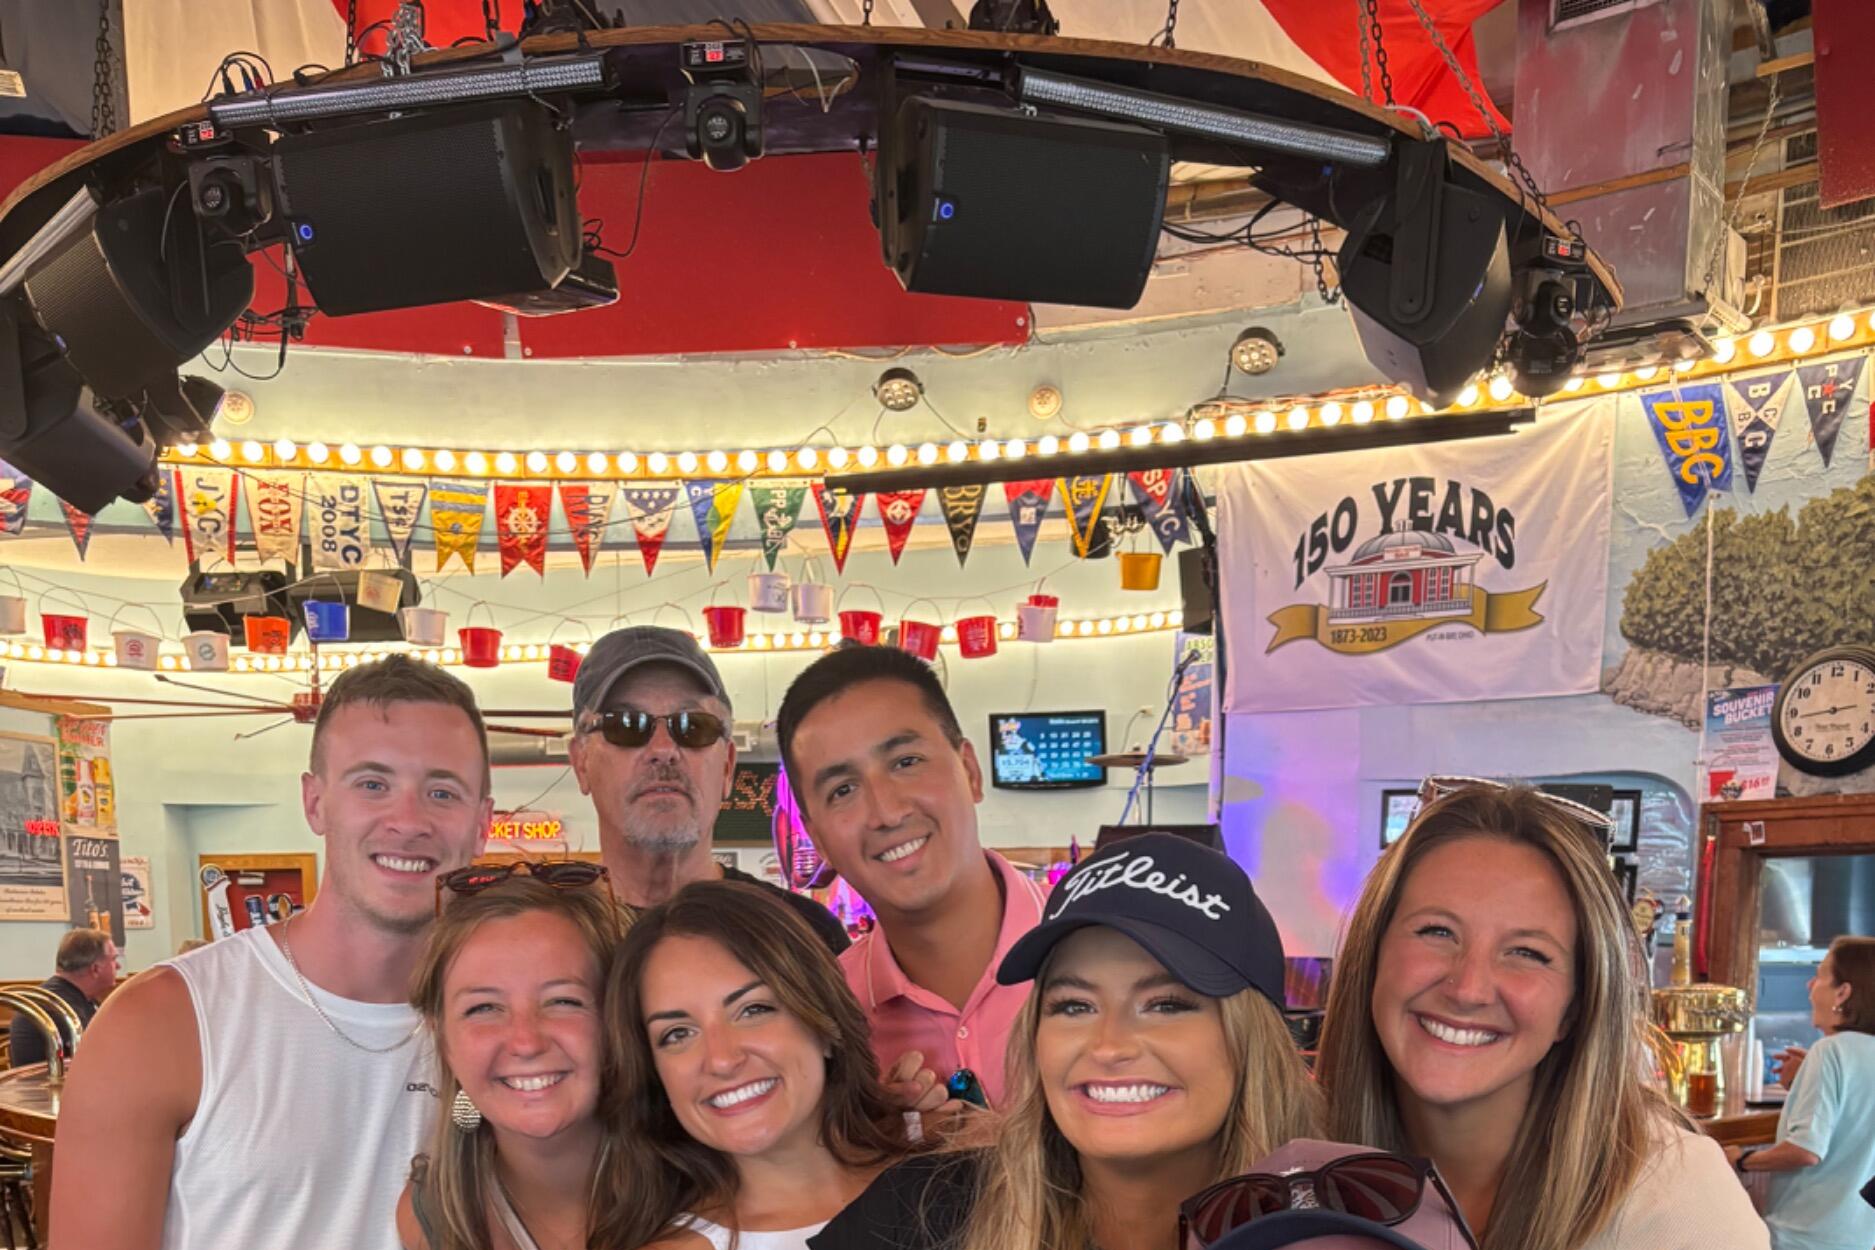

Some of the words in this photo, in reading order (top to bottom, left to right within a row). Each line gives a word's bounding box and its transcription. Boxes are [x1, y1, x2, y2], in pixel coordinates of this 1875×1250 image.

[1652, 400, 1725, 484] BBC
[1142, 469, 1180, 535] SPYC
[321, 495, 337, 552] 2008
[340, 485, 363, 565] DTYC
[1293, 496, 1358, 591] 150
[1371, 477, 1516, 570] YEARS
[1330, 627, 1388, 644] 1873-2023
[1812, 671, 1821, 685] 11
[1830, 665, 1844, 677] 12
[1853, 670, 1860, 682] 1
[1797, 687, 1811, 699] 10
[1713, 690, 1775, 717] SOUVENIR
[1724, 703, 1773, 725] BUCKET
[1790, 708, 1799, 718] 9
[1794, 726, 1803, 737] 8
[1861, 722, 1869, 733] 4
[1805, 739, 1814, 750] 7
[1825, 744, 1834, 755] 6
[1845, 736, 1854, 748] 5
[522, 820, 561, 839] SHOP
[72, 838, 108, 858] Tito's
[1049, 851, 1231, 920] Titleist
